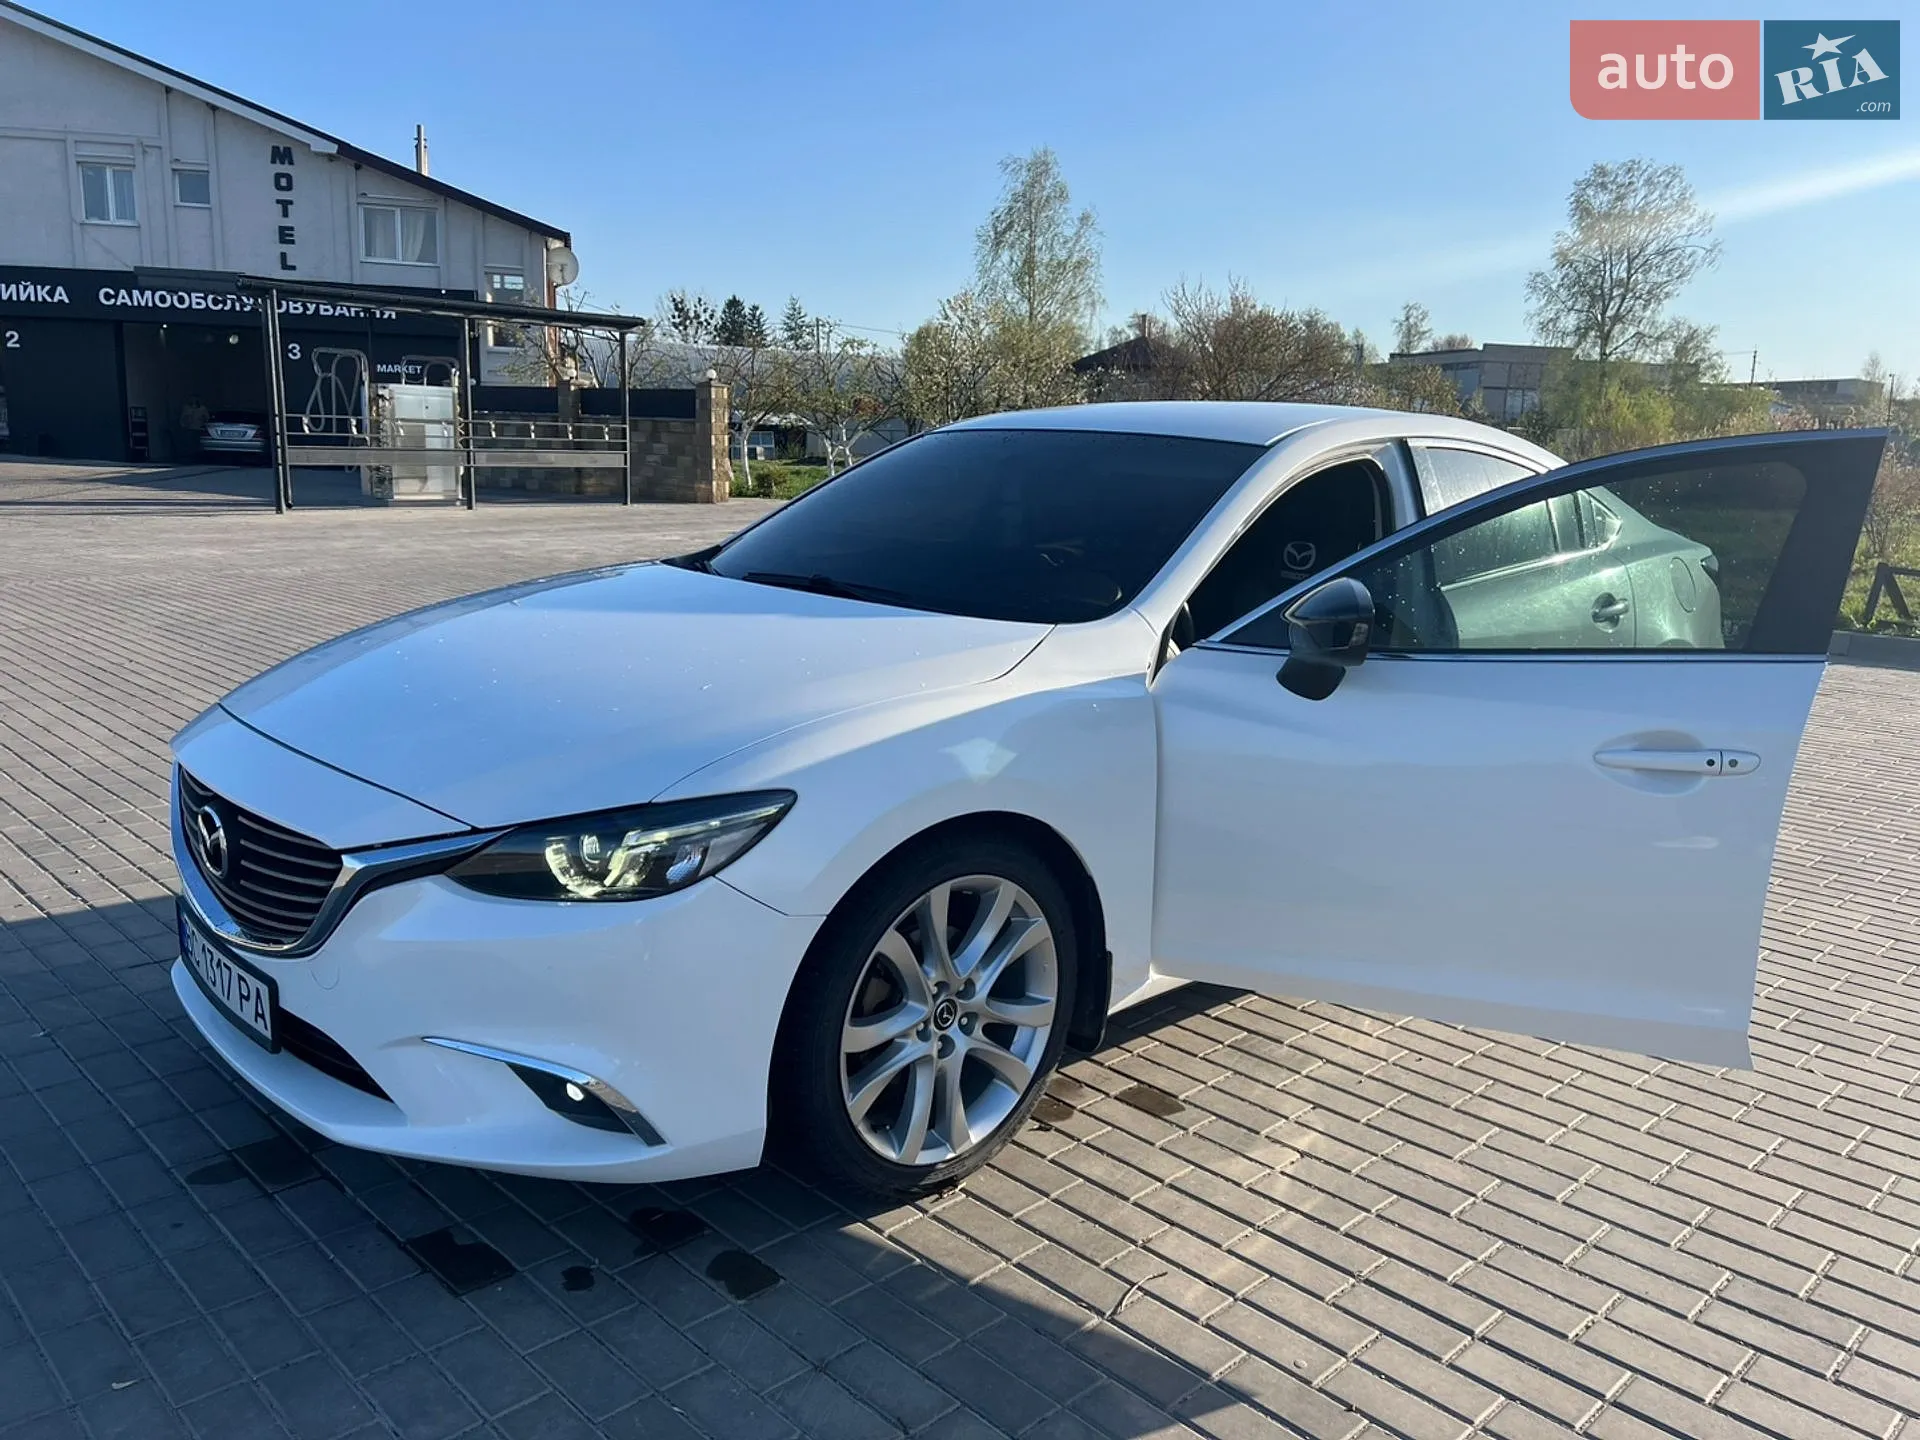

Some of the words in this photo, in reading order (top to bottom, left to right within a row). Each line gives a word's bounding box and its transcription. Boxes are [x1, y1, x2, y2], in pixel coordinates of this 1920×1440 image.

[270, 145, 297, 271] MOTEL
[0, 281, 70, 305] ИЙКА
[98, 287, 397, 320] САМООБСЛУОВУВАЯ
[5, 330, 21, 348] 2
[287, 343, 302, 360] 3
[376, 363, 422, 375] MARKET
[201, 943, 232, 1001] 1317
[237, 972, 269, 1031] PA
